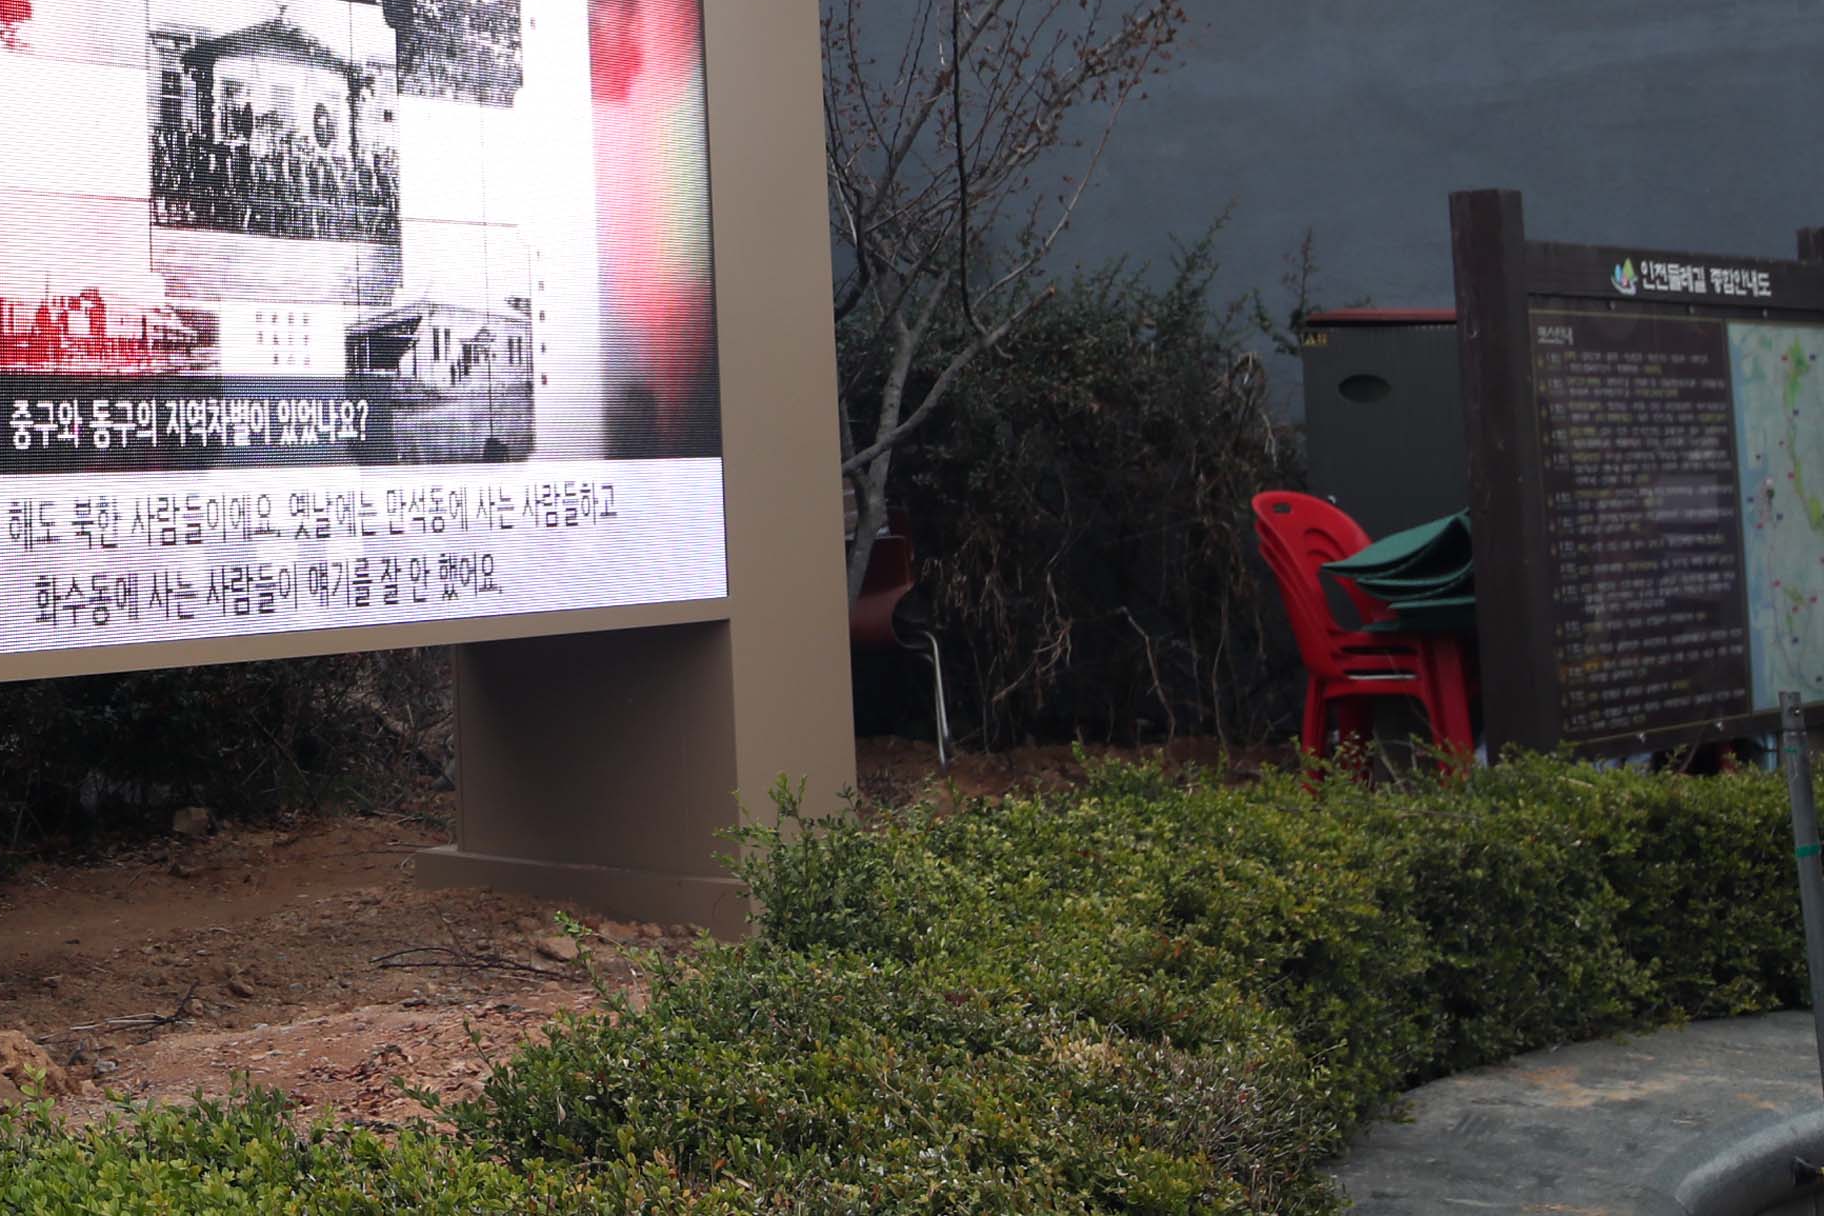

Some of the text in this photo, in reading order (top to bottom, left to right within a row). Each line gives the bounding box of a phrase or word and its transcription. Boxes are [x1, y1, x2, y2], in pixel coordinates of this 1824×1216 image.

[9, 398, 83, 450] 중구와
[90, 398, 158, 448] 동구의
[165, 398, 270, 447] 지역차별이
[277, 398, 370, 446] 있었나요?
[8, 499, 62, 553] 해도
[70, 495, 123, 550] 북한
[131, 492, 281, 546] 사람들이에요.
[289, 488, 377, 540] 옛날에는
[386, 486, 469, 535] 만석동에
[476, 483, 515, 531] 사는
[522, 479, 617, 529] 사람들하고
[35, 551, 504, 627] 화수동에 사는 사람들이 얘기를 잘 안 했어요.
